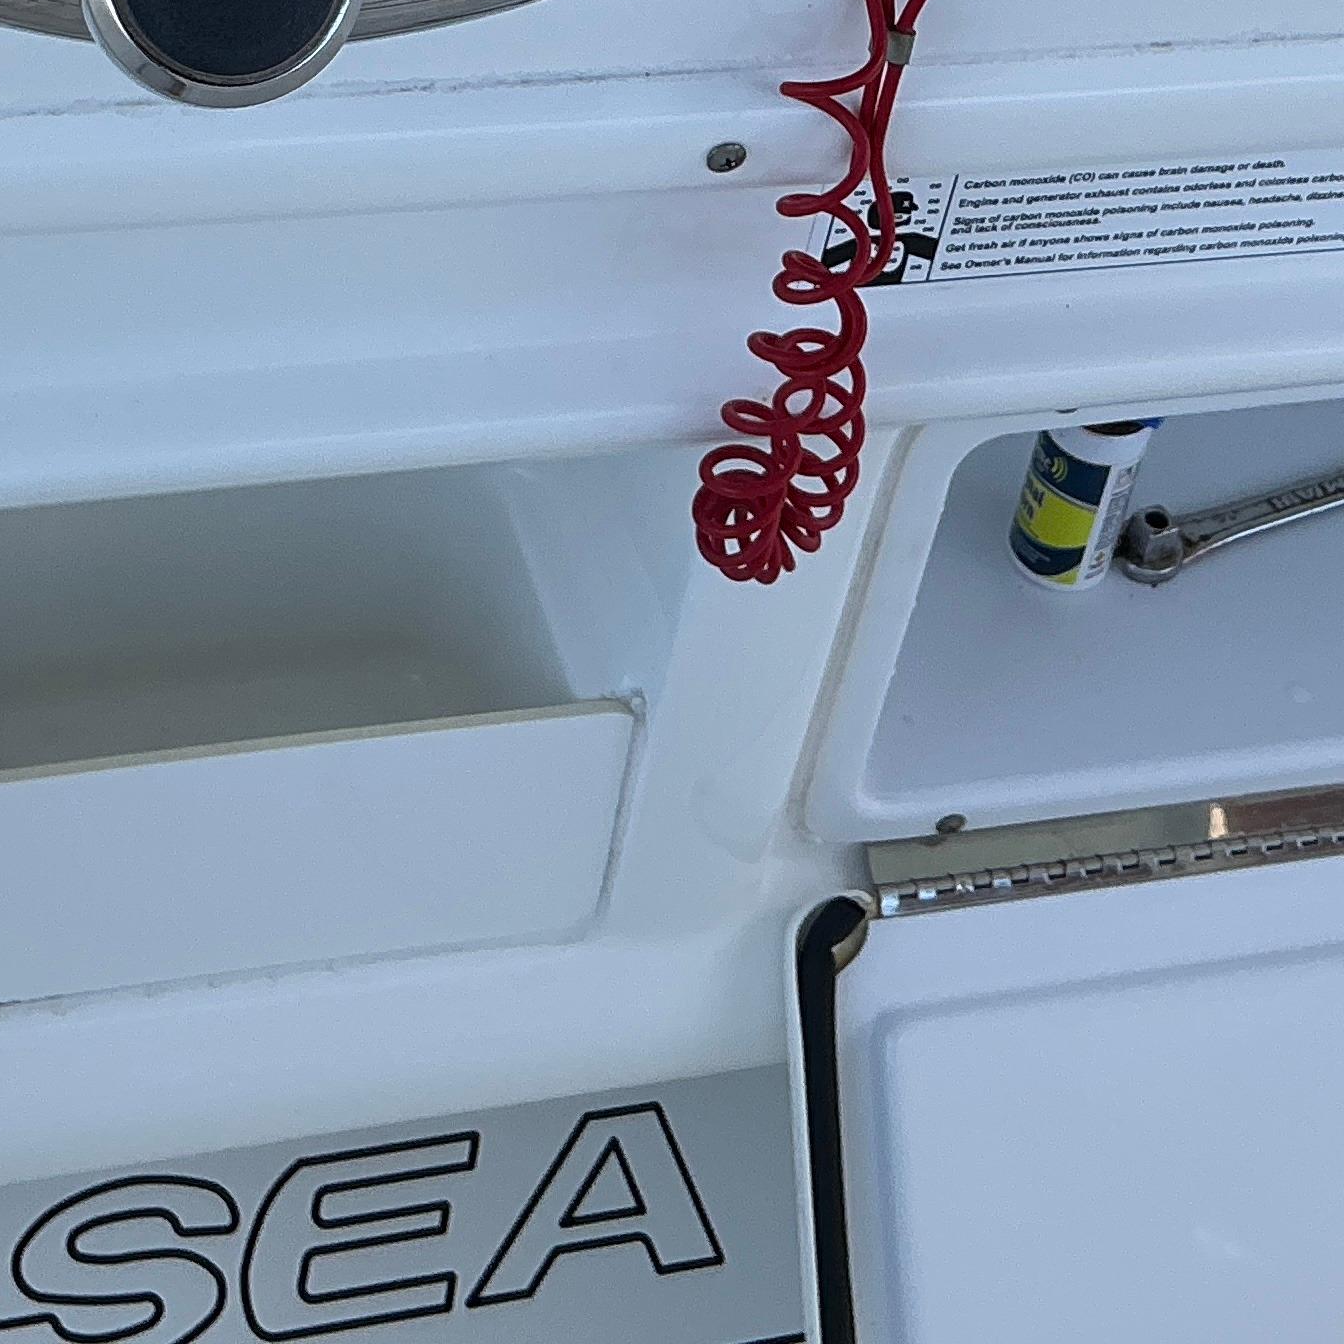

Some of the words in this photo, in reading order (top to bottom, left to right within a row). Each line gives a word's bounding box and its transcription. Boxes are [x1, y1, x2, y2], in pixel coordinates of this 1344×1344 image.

[964, 180, 1006, 190] Carbon
[1009, 174, 1066, 187] monoxide
[1068, 172, 1096, 184] (CO)
[1098, 172, 1119, 181] can
[1122, 169, 1156, 179] cause
[1158, 166, 1187, 176] brain
[1190, 163, 1235, 174] damage
[1237, 162, 1250, 171] or
[959, 197, 999, 209] Engine
[1002, 195, 1024, 205] and
[1026, 191, 1082, 205] generator
[1084, 187, 1130, 199] exhaust
[1132, 184, 1181, 196] contains
[1183, 180, 1232, 192] odorless
[1234, 177, 1256, 189] and
[1258, 176, 1309, 187] colorless
[951, 224, 973, 235] and
[975, 222, 998, 233] lack
[1001, 221, 1014, 231] of
[1015, 216, 1101, 231] consciousness.
[954, 216, 986, 227] Signs
[988, 213, 1001, 224] of
[1003, 212, 1042, 223] carbon
[1045, 206, 1100, 219] monoxide
[1102, 203, 1158, 217] poisoning
[1160, 199, 1201, 211] include
[946, 243, 966, 253] Get
[968, 240, 998, 251] fresh
[1001, 239, 1016, 249] air
[1018, 237, 1027, 248] if
[1029, 236, 1071, 248] anyone
[1074, 234, 1110, 244] shows
[1113, 231, 1144, 242] signs
[1146, 227, 1159, 239] of
[1160, 226, 1199, 237] carbon
[1201, 221, 1256, 234] monoxide
[940, 261, 962, 271] See
[965, 257, 1011, 269] Owner's
[1013, 253, 1056, 265] Manual
[1058, 252, 1075, 262] for
[1076, 248, 1141, 260] information
[1143, 243, 1197, 256] regarding
[1199, 240, 1238, 251] carbon
[1239, 236, 1294, 248] monoxide
